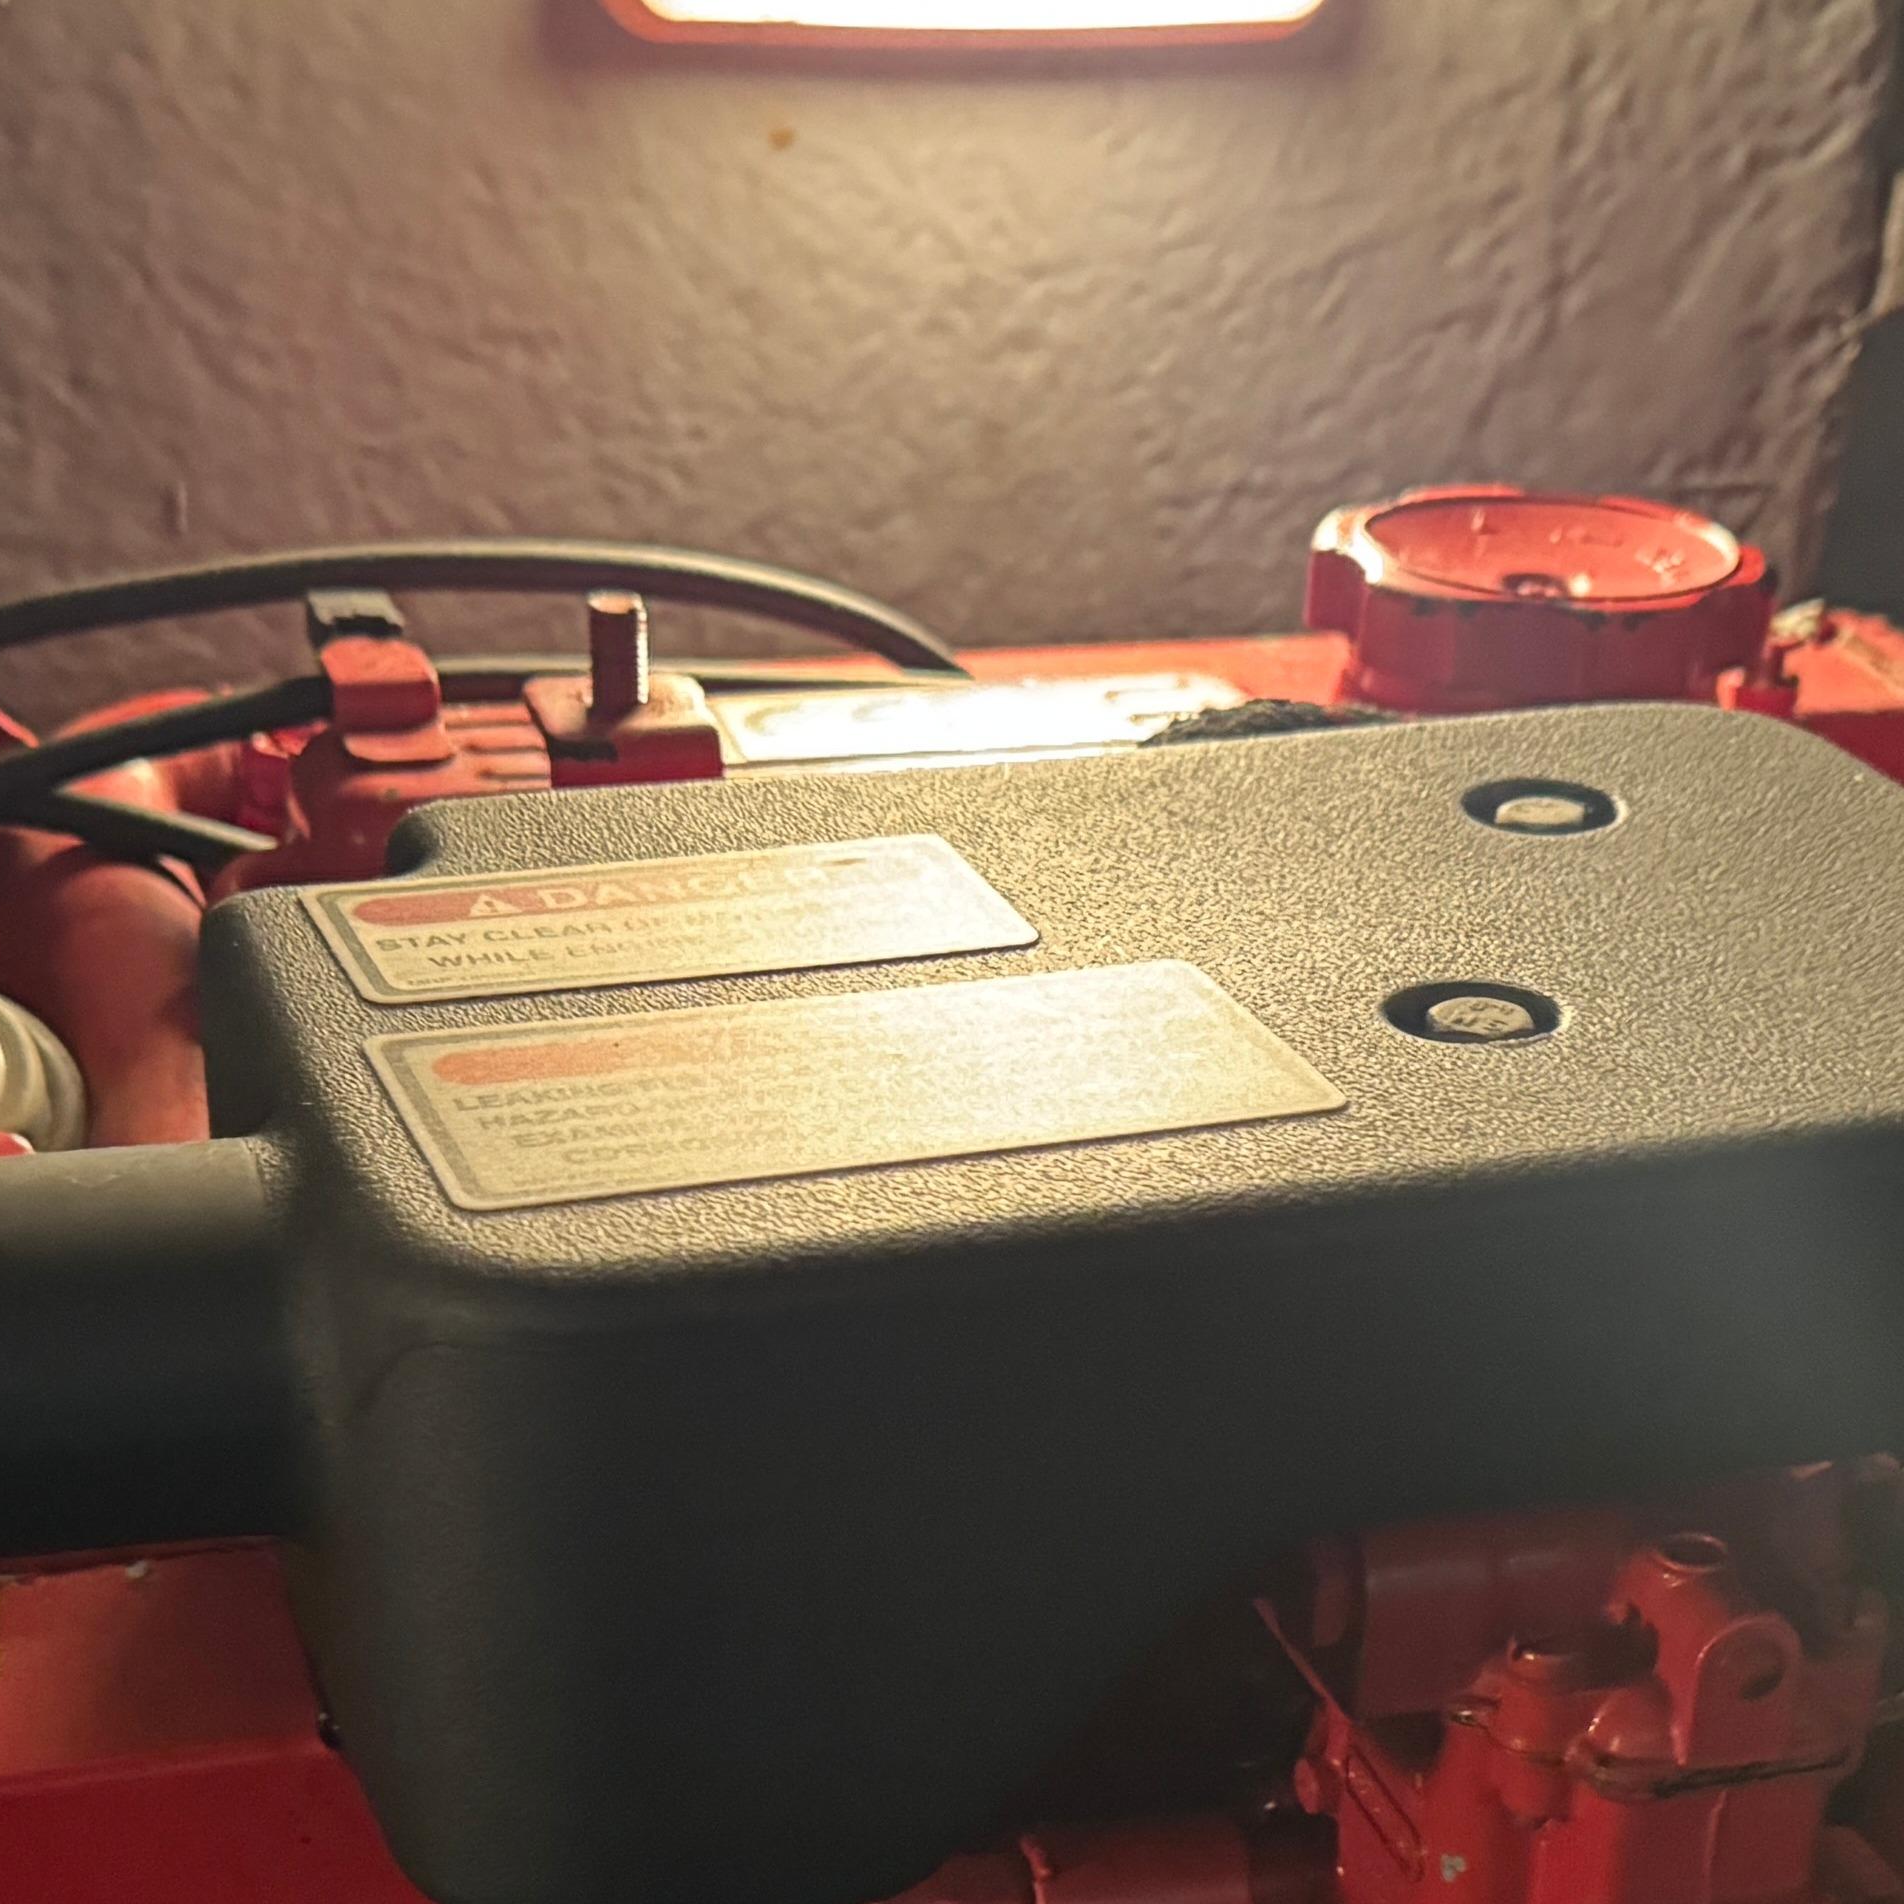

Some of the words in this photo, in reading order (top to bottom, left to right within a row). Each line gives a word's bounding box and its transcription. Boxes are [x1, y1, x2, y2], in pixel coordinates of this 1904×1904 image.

[376, 932, 466, 952] STAY
[482, 921, 613, 943] CLEAR
[426, 949, 556, 968] WHILE
